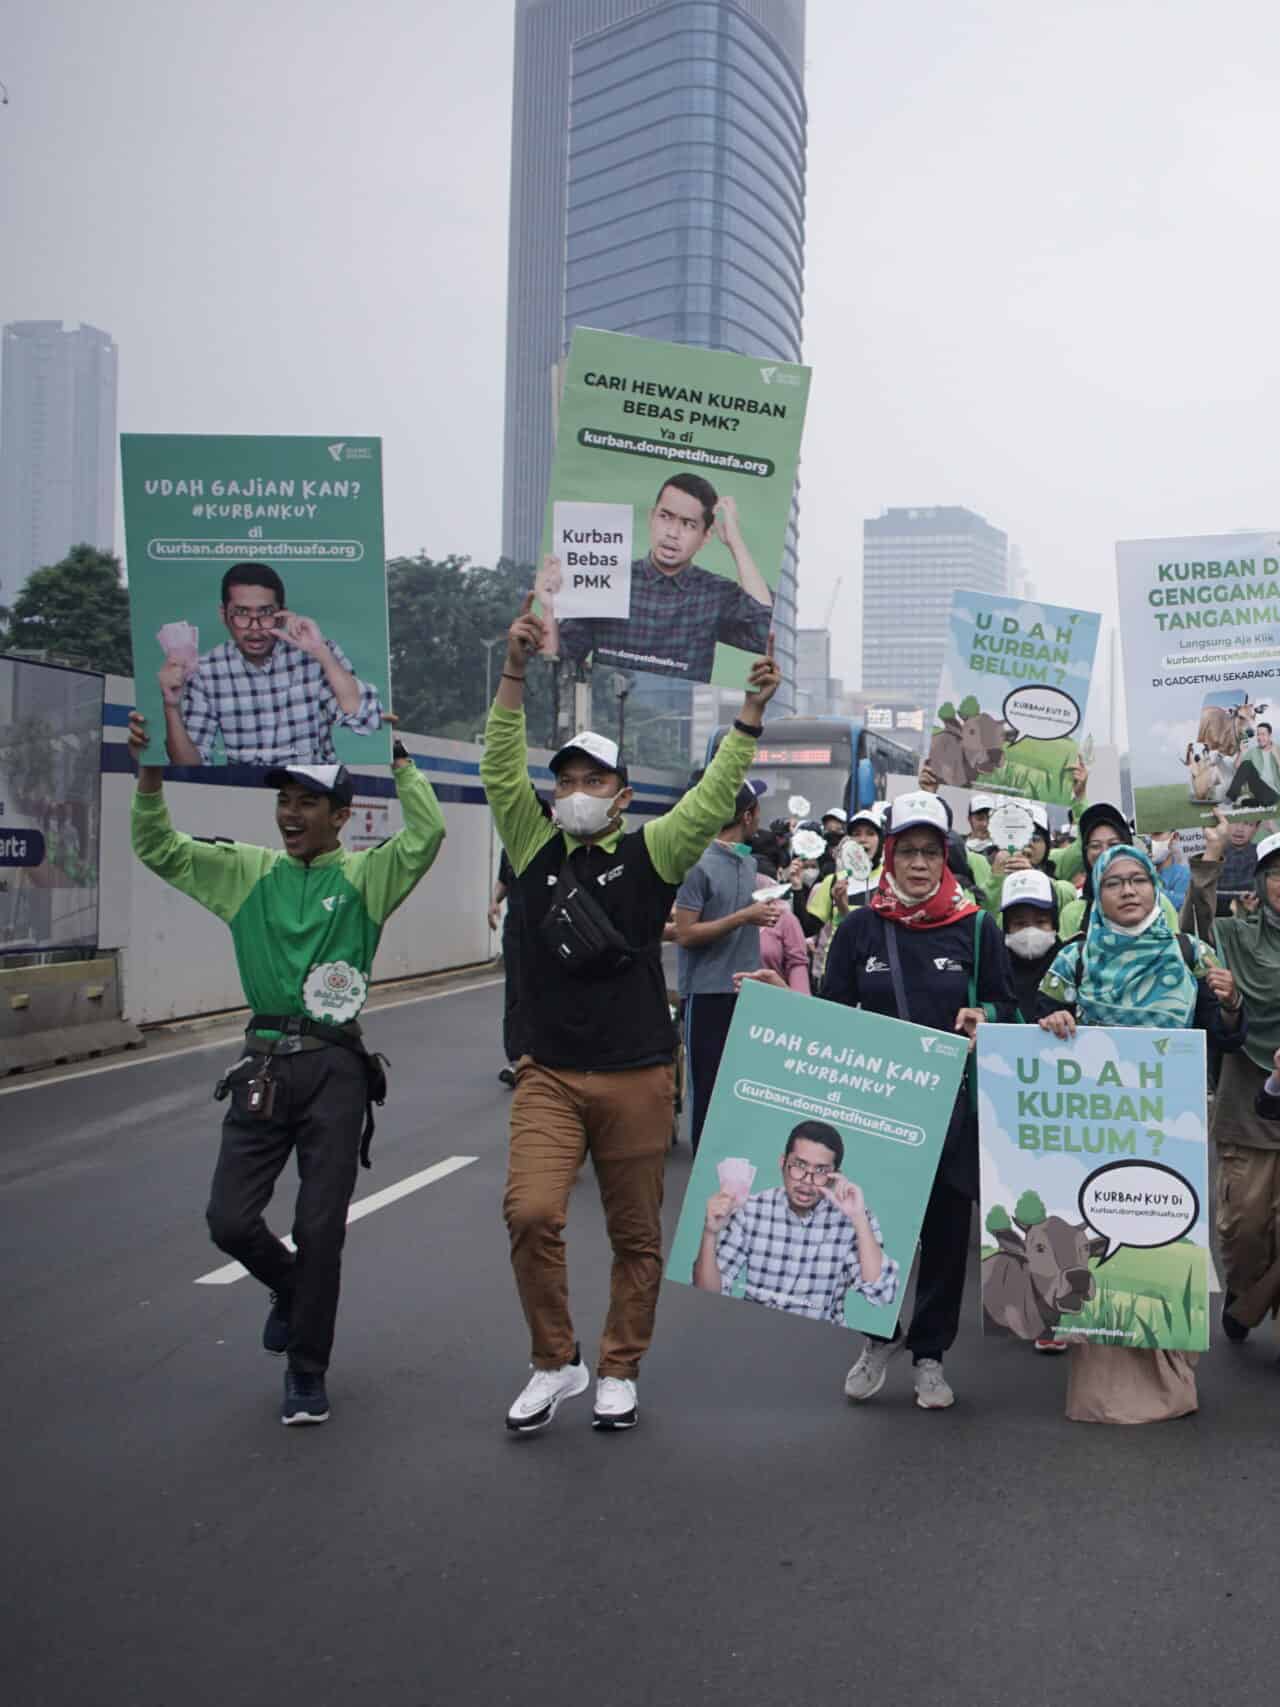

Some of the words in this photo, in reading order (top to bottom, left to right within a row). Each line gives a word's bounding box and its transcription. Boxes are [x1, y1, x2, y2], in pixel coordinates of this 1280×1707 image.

[583, 372, 627, 392] CARI
[631, 380, 703, 404] HEWAN
[708, 392, 787, 418] KURBAN
[623, 400, 684, 423] BEBAS
[689, 411, 740, 431] PMK?
[659, 427, 676, 441] Ya
[679, 431, 694, 443] di
[583, 431, 769, 475] kurban.dompetdhuafa.org
[145, 479, 203, 497] UDAH
[302, 479, 361, 499] KAN?
[192, 503, 318, 520] #KURBANKUY
[248, 526, 263, 539] di
[562, 529, 623, 544] Kurban
[156, 541, 356, 558] kurban.dompetdhuafa.org
[567, 551, 618, 566] Bebas
[573, 574, 611, 589] PMK
[1157, 559, 1256, 582] KURBAN
[975, 612, 1073, 644] UDAH
[972, 633, 1069, 665] KURBAN
[1179, 636, 1232, 650] Langsung
[1254, 633, 1274, 643] Klik
[969, 653, 1048, 683] BELUM
[1152, 678, 1163, 687] DI
[1164, 673, 1221, 686] GADGETMU
[1223, 669, 1276, 681] SEKARANG
[749, 1024, 803, 1052] UDAH
[885, 1060, 941, 1091] KAN?
[783, 1057, 897, 1098] #KURBANKUY
[1017, 1056, 1163, 1089] UDAH
[827, 1091, 840, 1103] di
[1017, 1090, 1164, 1123] KURBAN
[741, 1082, 919, 1142] kurban.dompetdhuafa.org
[1017, 1123, 1135, 1154] BELUM
[1094, 1189, 1142, 1203] KURBAN
[1145, 1192, 1169, 1206] KUY
